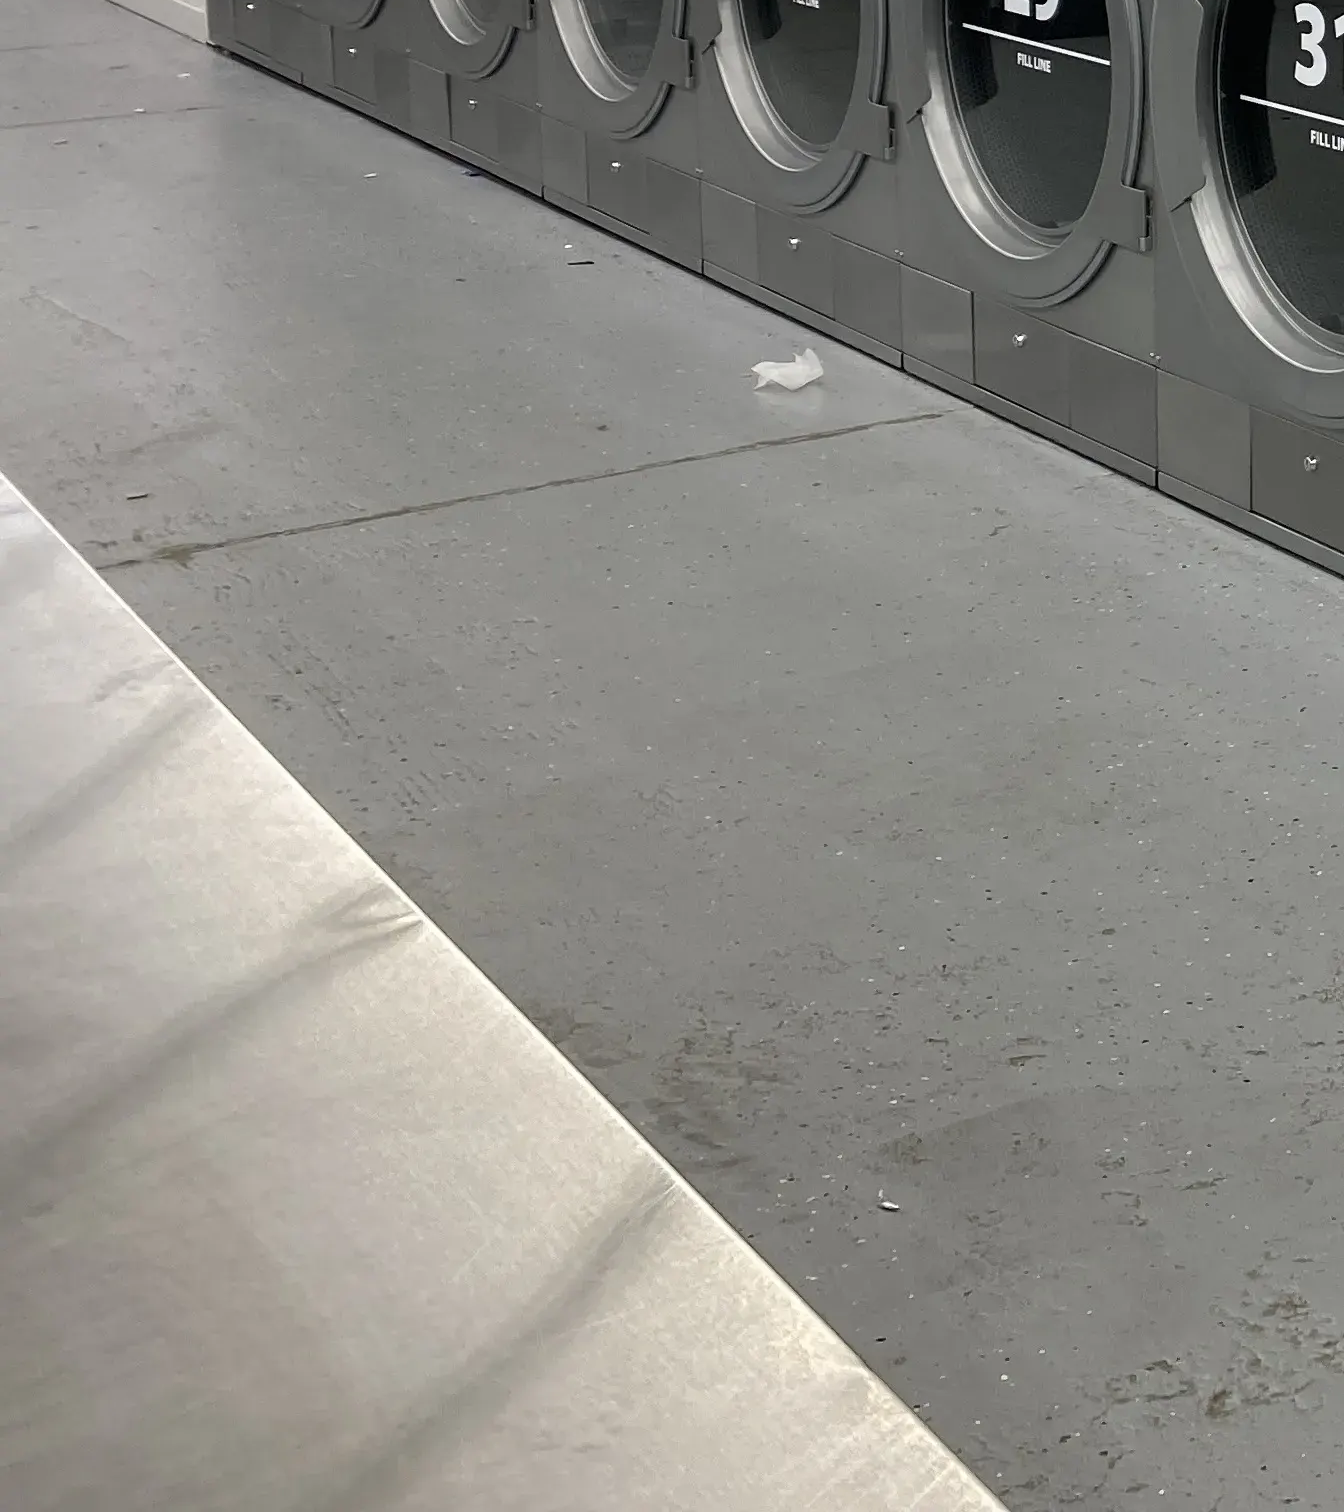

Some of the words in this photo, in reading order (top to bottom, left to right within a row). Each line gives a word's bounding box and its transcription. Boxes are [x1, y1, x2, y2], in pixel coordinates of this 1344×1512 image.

[1017, 52, 1033, 68] FILL
[1034, 57, 1051, 73] LINE
[1311, 129, 1330, 148] FILL
